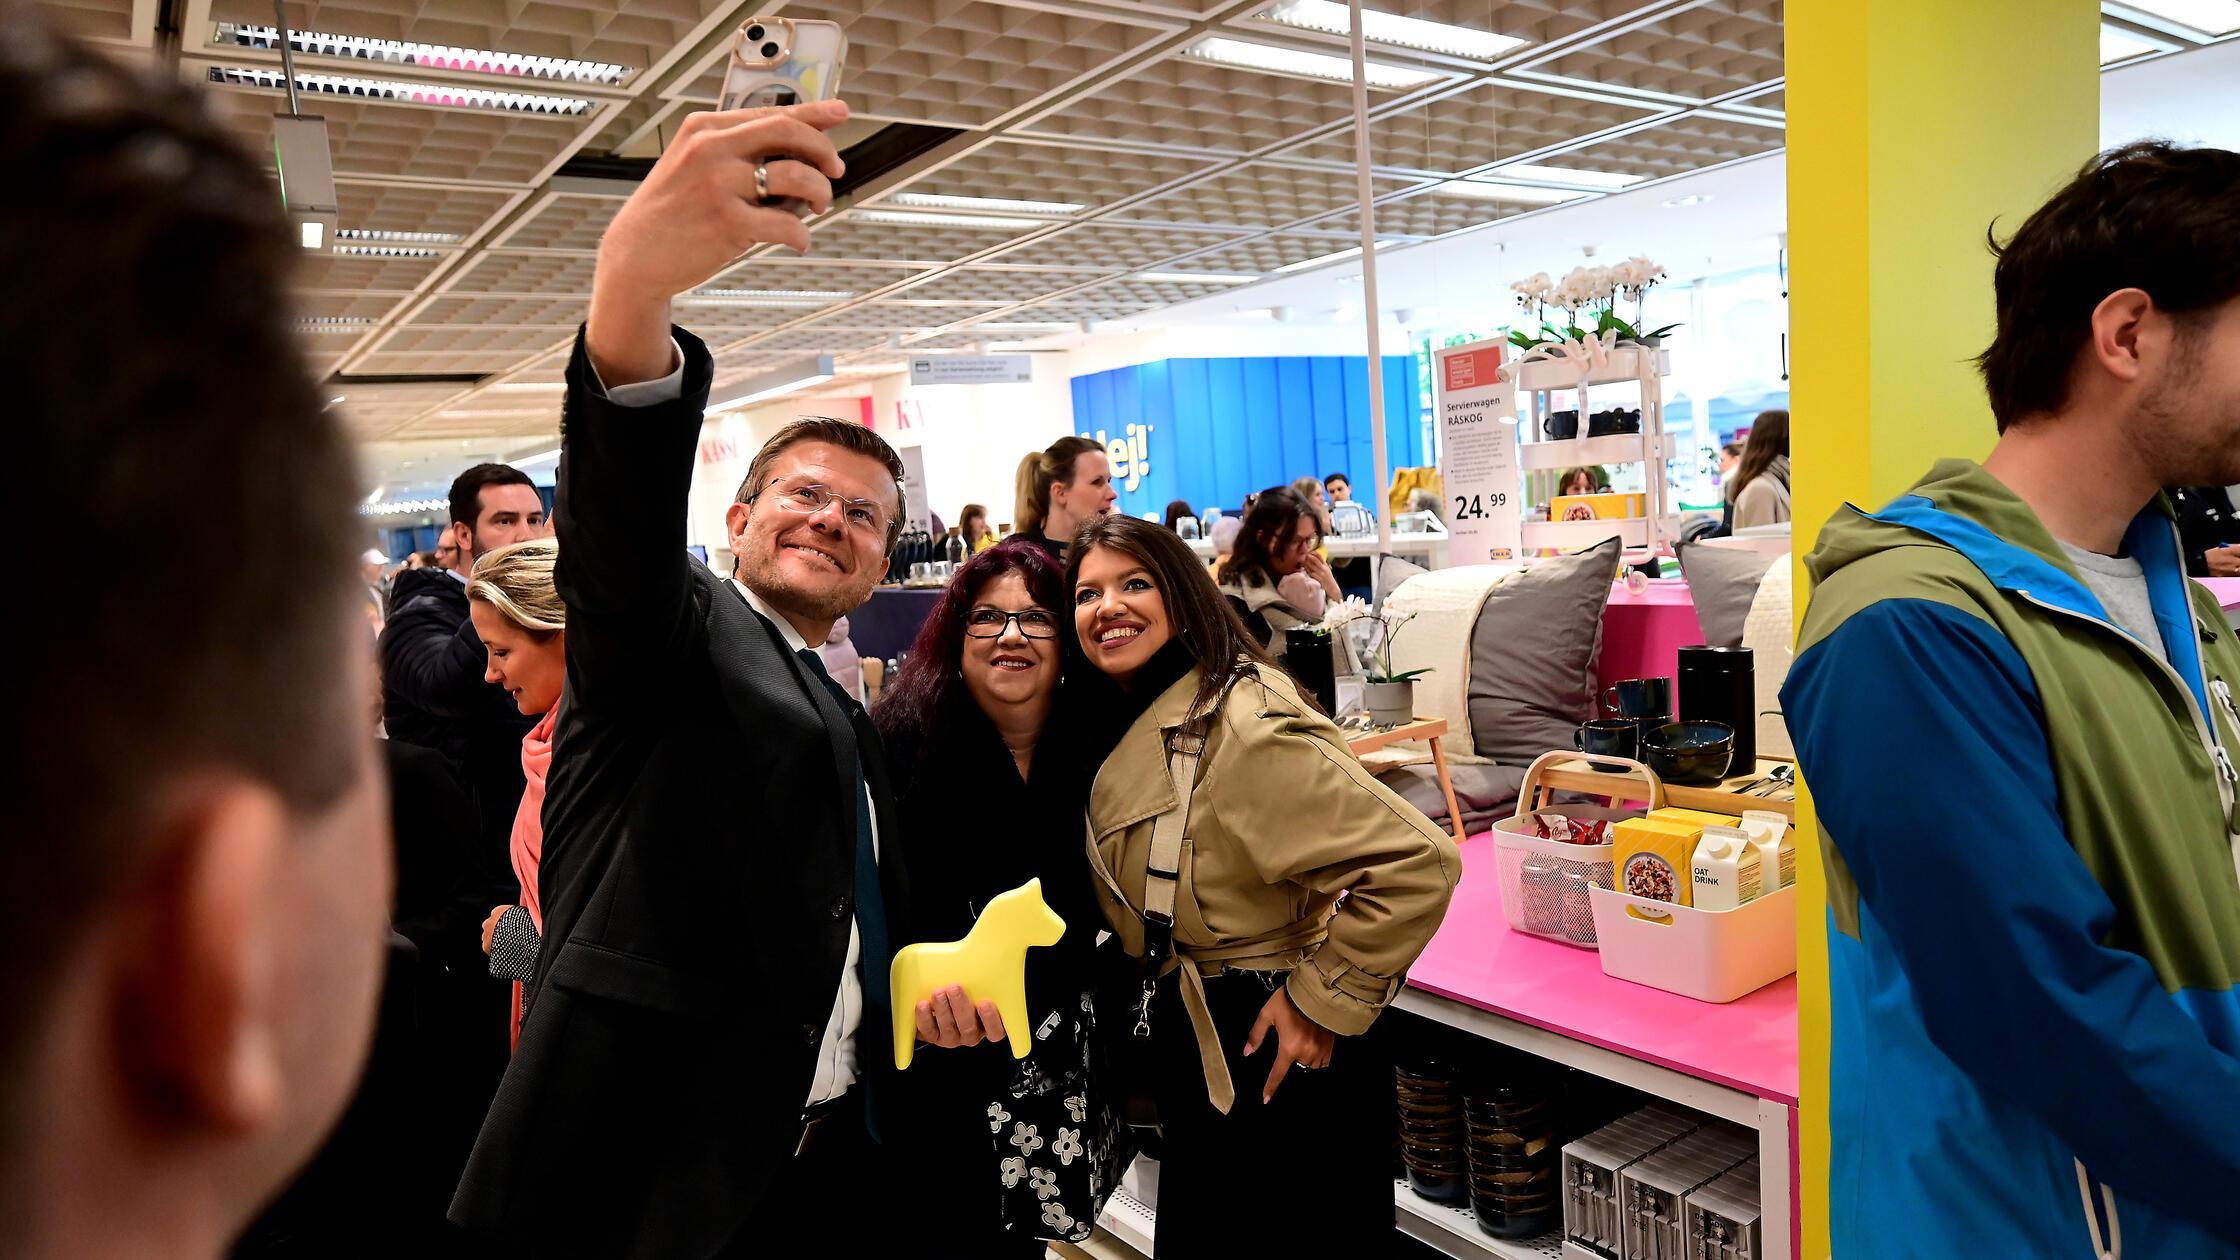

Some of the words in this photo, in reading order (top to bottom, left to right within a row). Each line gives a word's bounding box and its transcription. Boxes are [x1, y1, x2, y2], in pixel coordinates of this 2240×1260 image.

[1447, 397, 1500, 411] Servierwagen
[1080, 422, 1150, 492] ej!
[1694, 867, 1709, 877] OAT
[1694, 875, 1719, 887] DRINK
